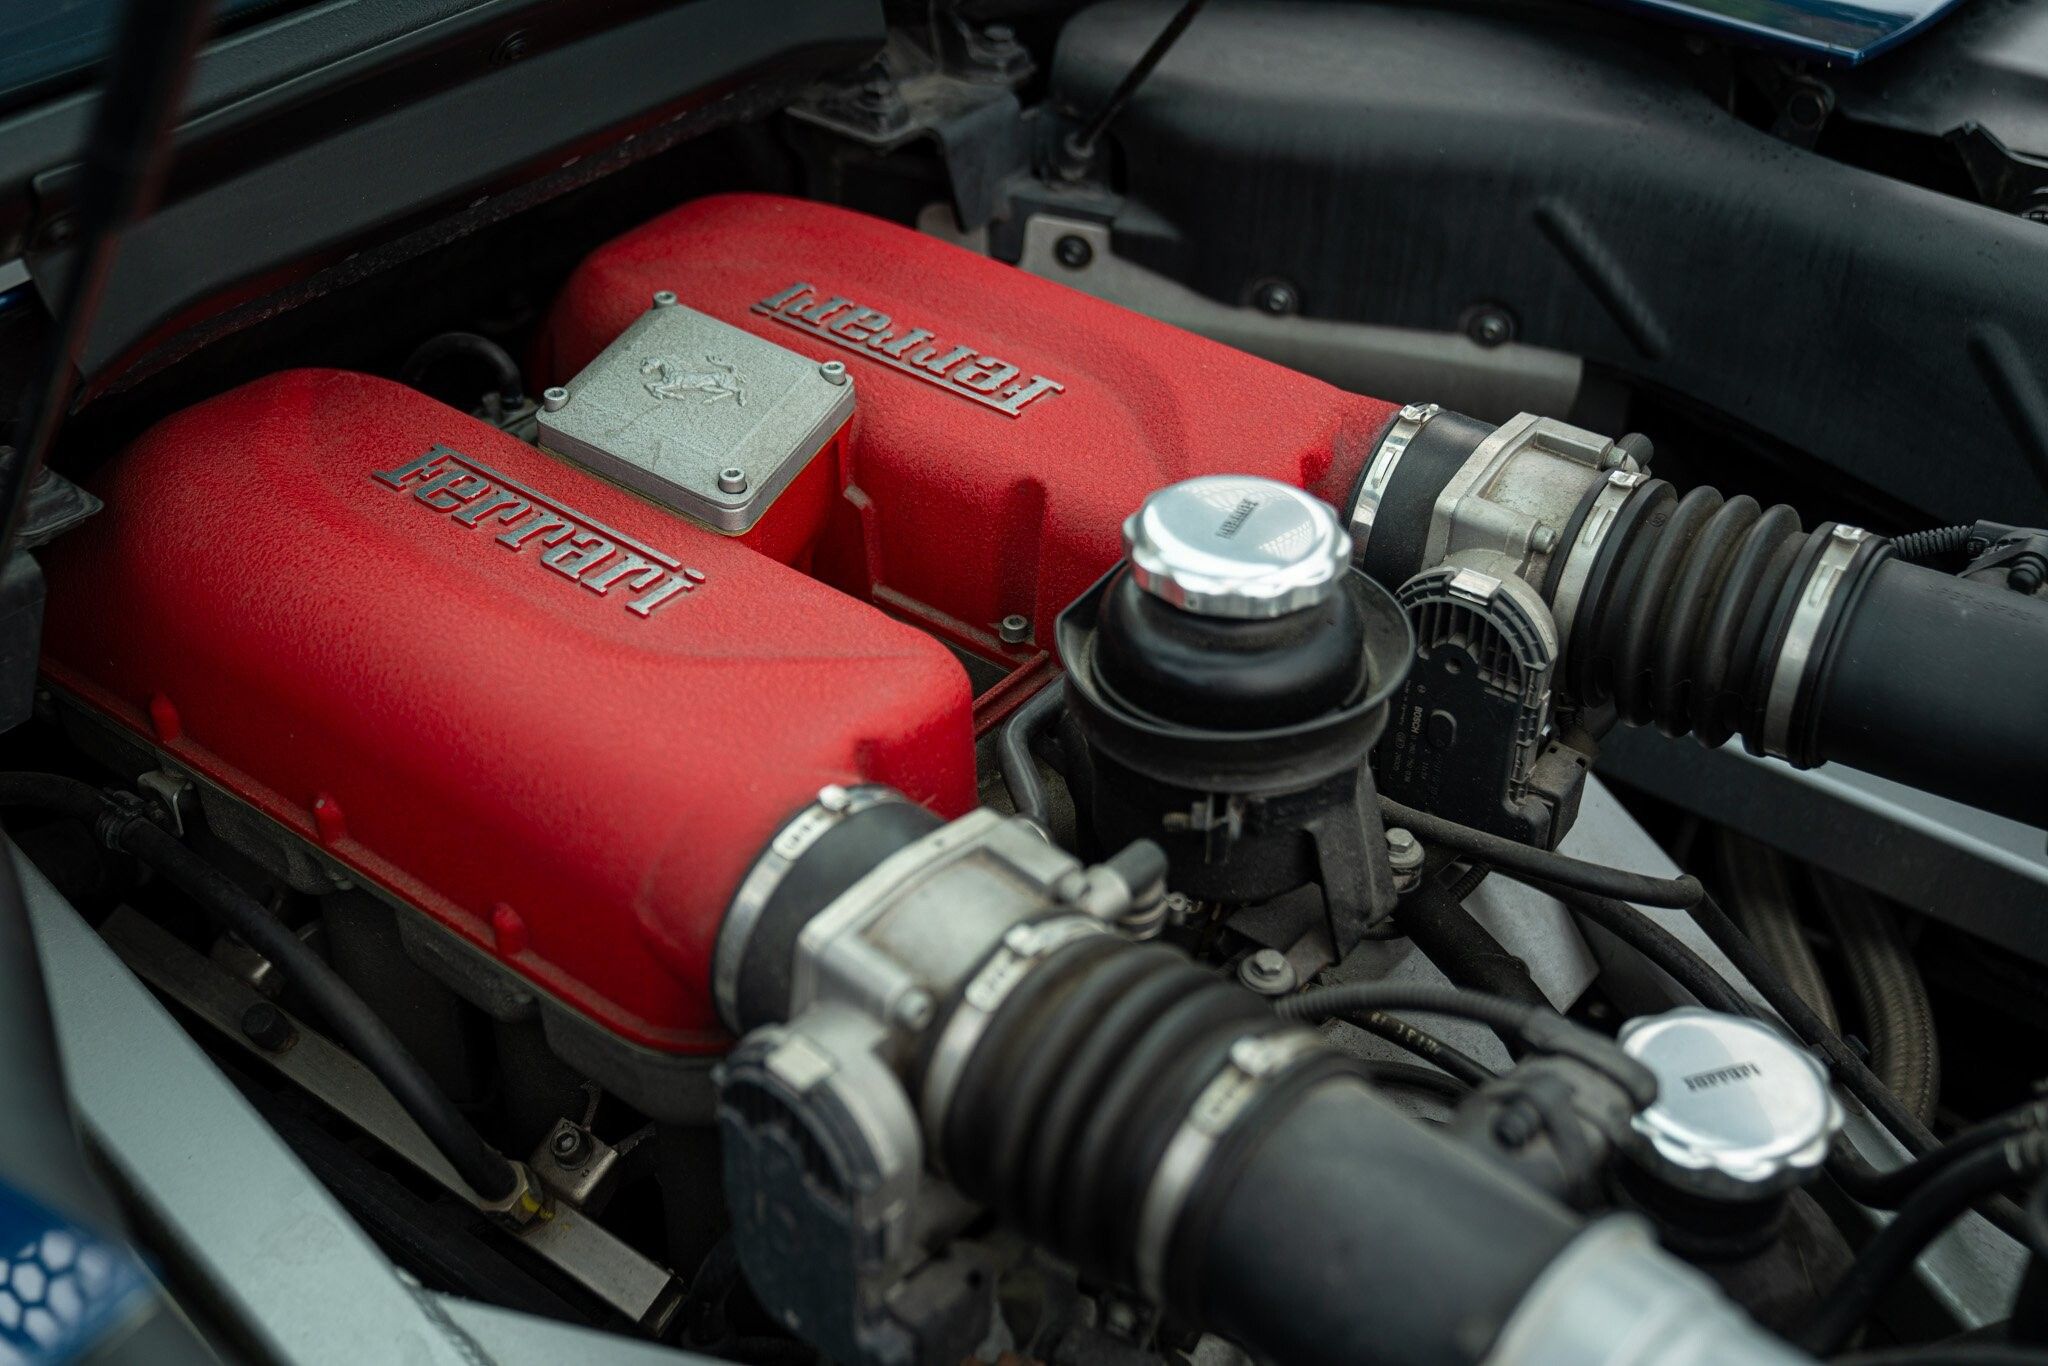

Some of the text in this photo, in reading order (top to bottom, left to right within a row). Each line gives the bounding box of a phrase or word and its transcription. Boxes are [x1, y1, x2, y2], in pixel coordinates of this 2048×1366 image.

[751, 281, 1066, 420] Ferrari
[371, 443, 706, 619] Ferrari
[1411, 705, 1424, 734] BOSCH
